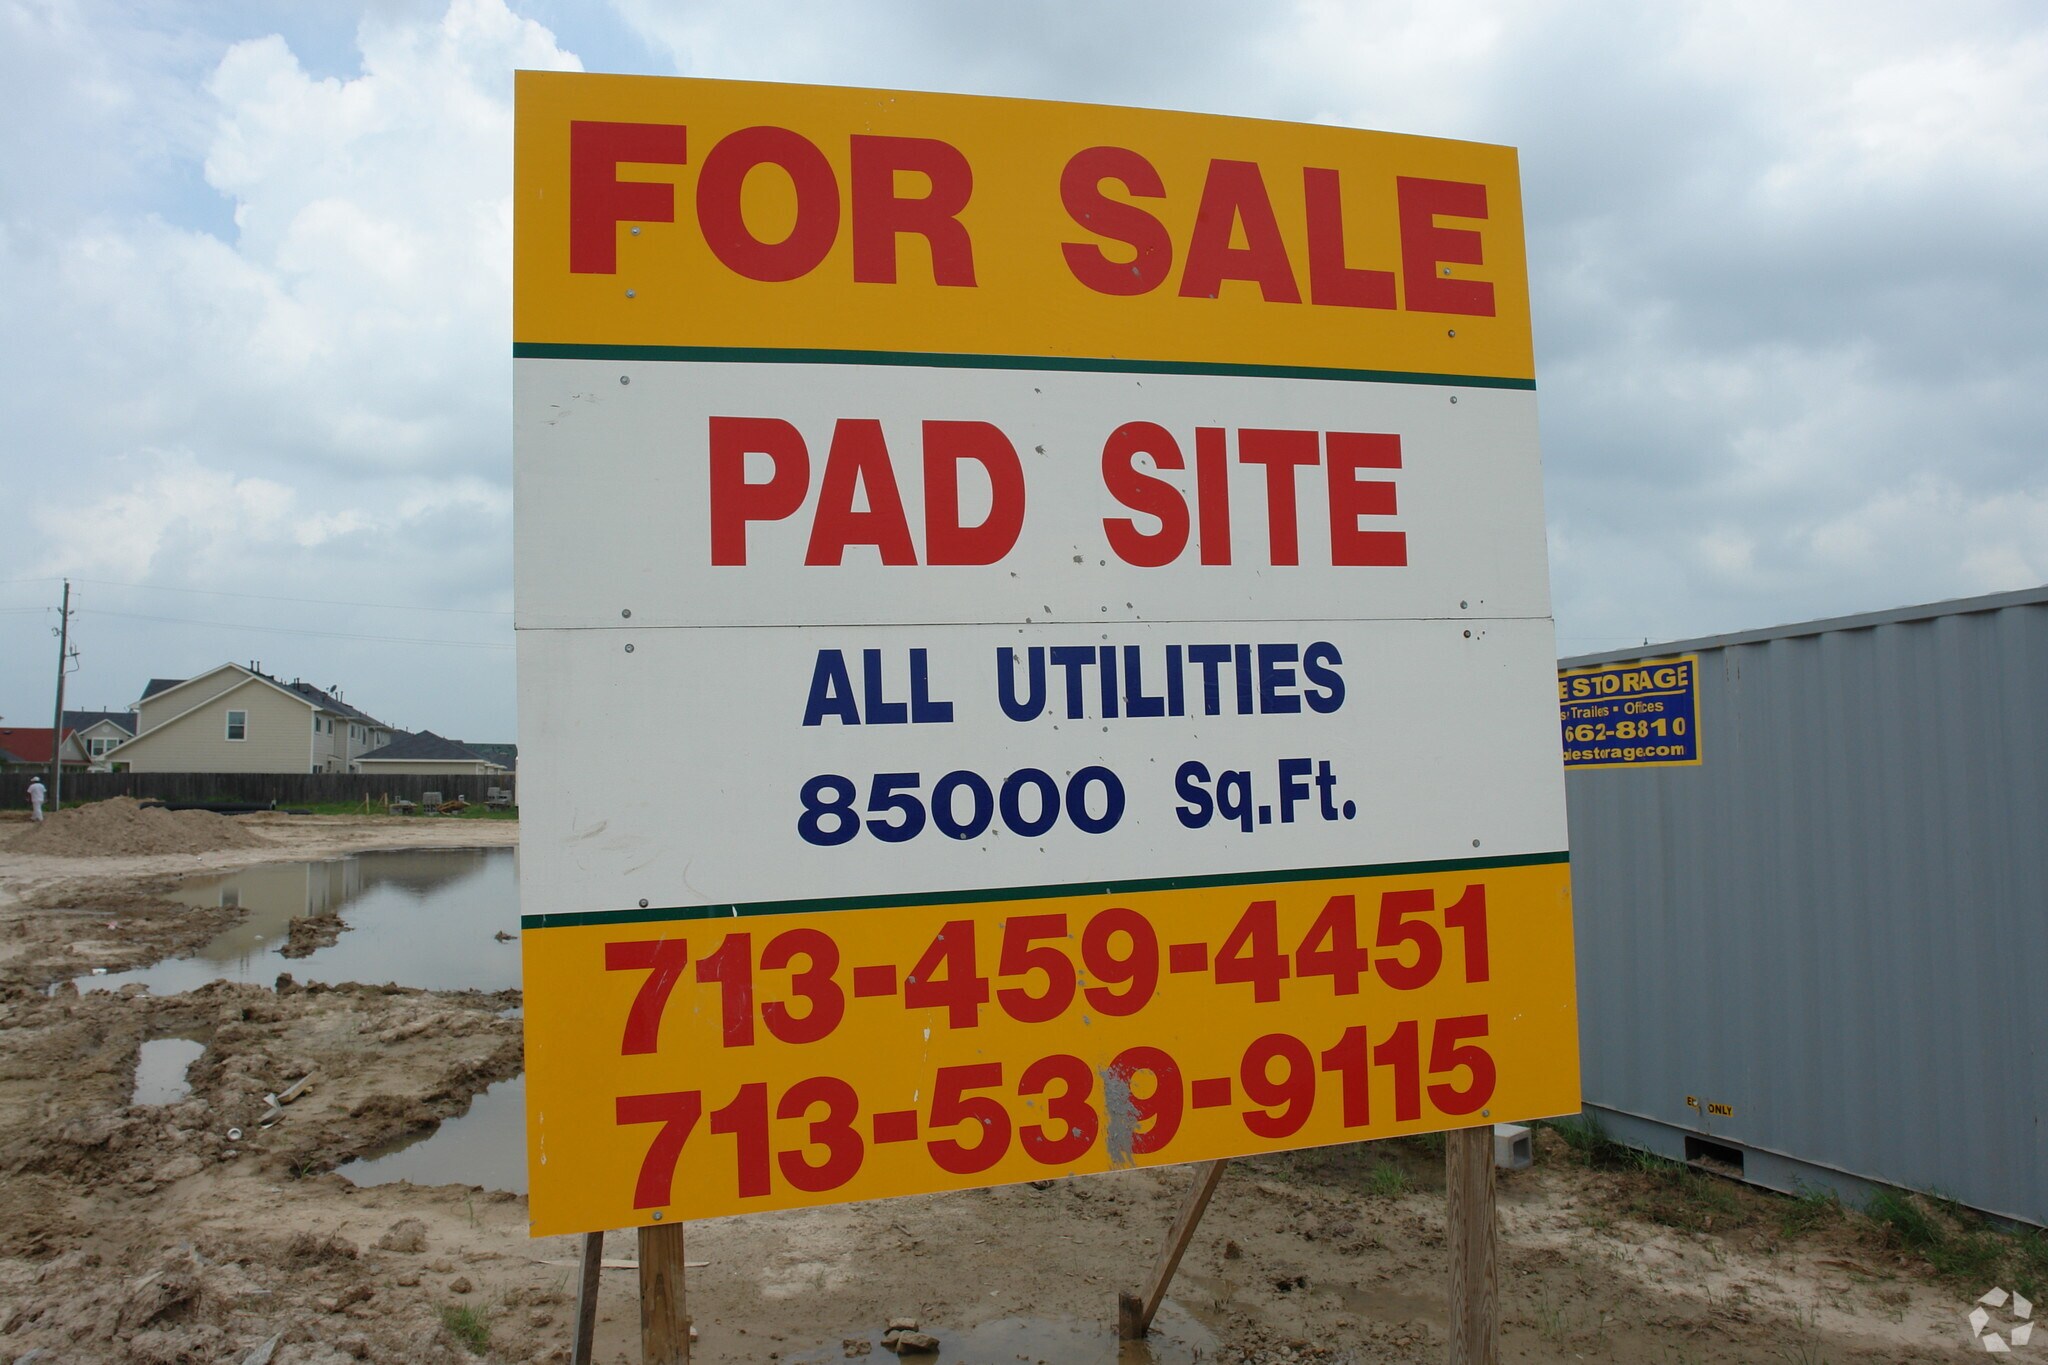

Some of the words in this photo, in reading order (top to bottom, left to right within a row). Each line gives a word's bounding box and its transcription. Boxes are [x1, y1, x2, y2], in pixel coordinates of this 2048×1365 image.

[569, 120, 978, 289] FOR
[1059, 145, 1497, 318] SALE
[709, 416, 1025, 567] PAD
[1101, 420, 1408, 568] SITE
[802, 647, 955, 728] ALL
[996, 640, 1346, 723] UTILITIES
[1573, 666, 1688, 697] STORAGE
[797, 765, 1126, 848] 85000
[1174, 757, 1358, 833] Sq.Ft.
[603, 882, 1491, 1057] 713-459-4451
[614, 1013, 1498, 1211] 713-539-9115
[1708, 1104, 1732, 1116] ONLY
